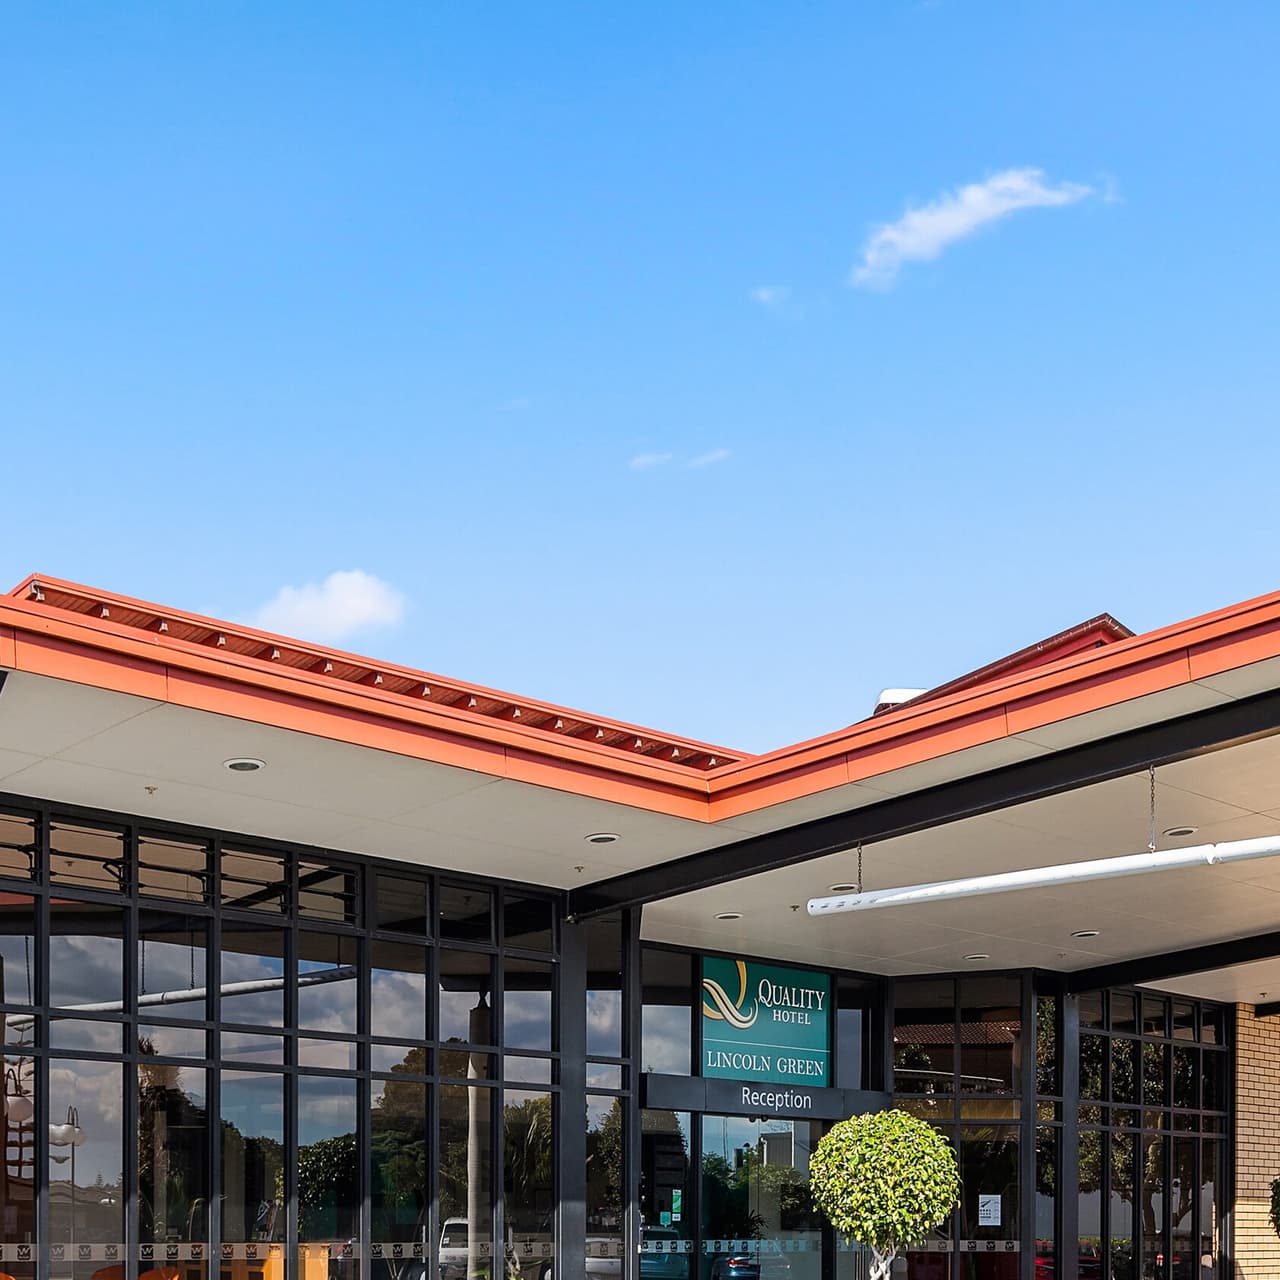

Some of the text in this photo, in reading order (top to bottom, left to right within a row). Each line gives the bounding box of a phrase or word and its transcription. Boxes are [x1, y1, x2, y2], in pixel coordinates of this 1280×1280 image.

[773, 1009, 811, 1025] HOTEL
[707, 1050, 824, 1076] LINCOLN GREEN
[742, 1086, 812, 1111] Reception
